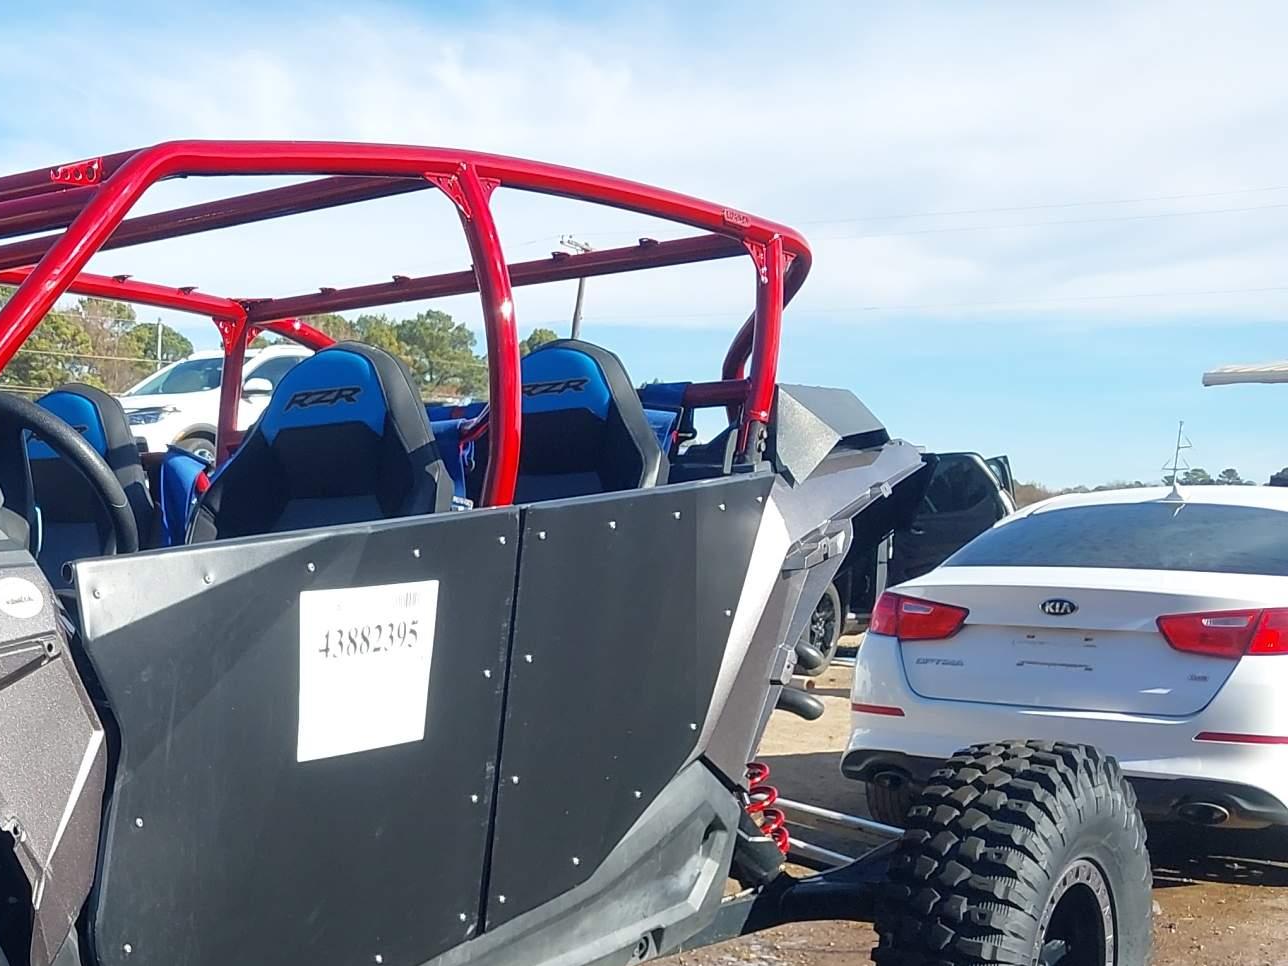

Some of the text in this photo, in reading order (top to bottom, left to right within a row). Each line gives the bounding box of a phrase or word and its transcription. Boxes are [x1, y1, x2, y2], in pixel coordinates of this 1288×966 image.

[282, 384, 363, 413] RZR
[1043, 600, 1074, 615] KIA
[318, 619, 419, 659] 43882395
